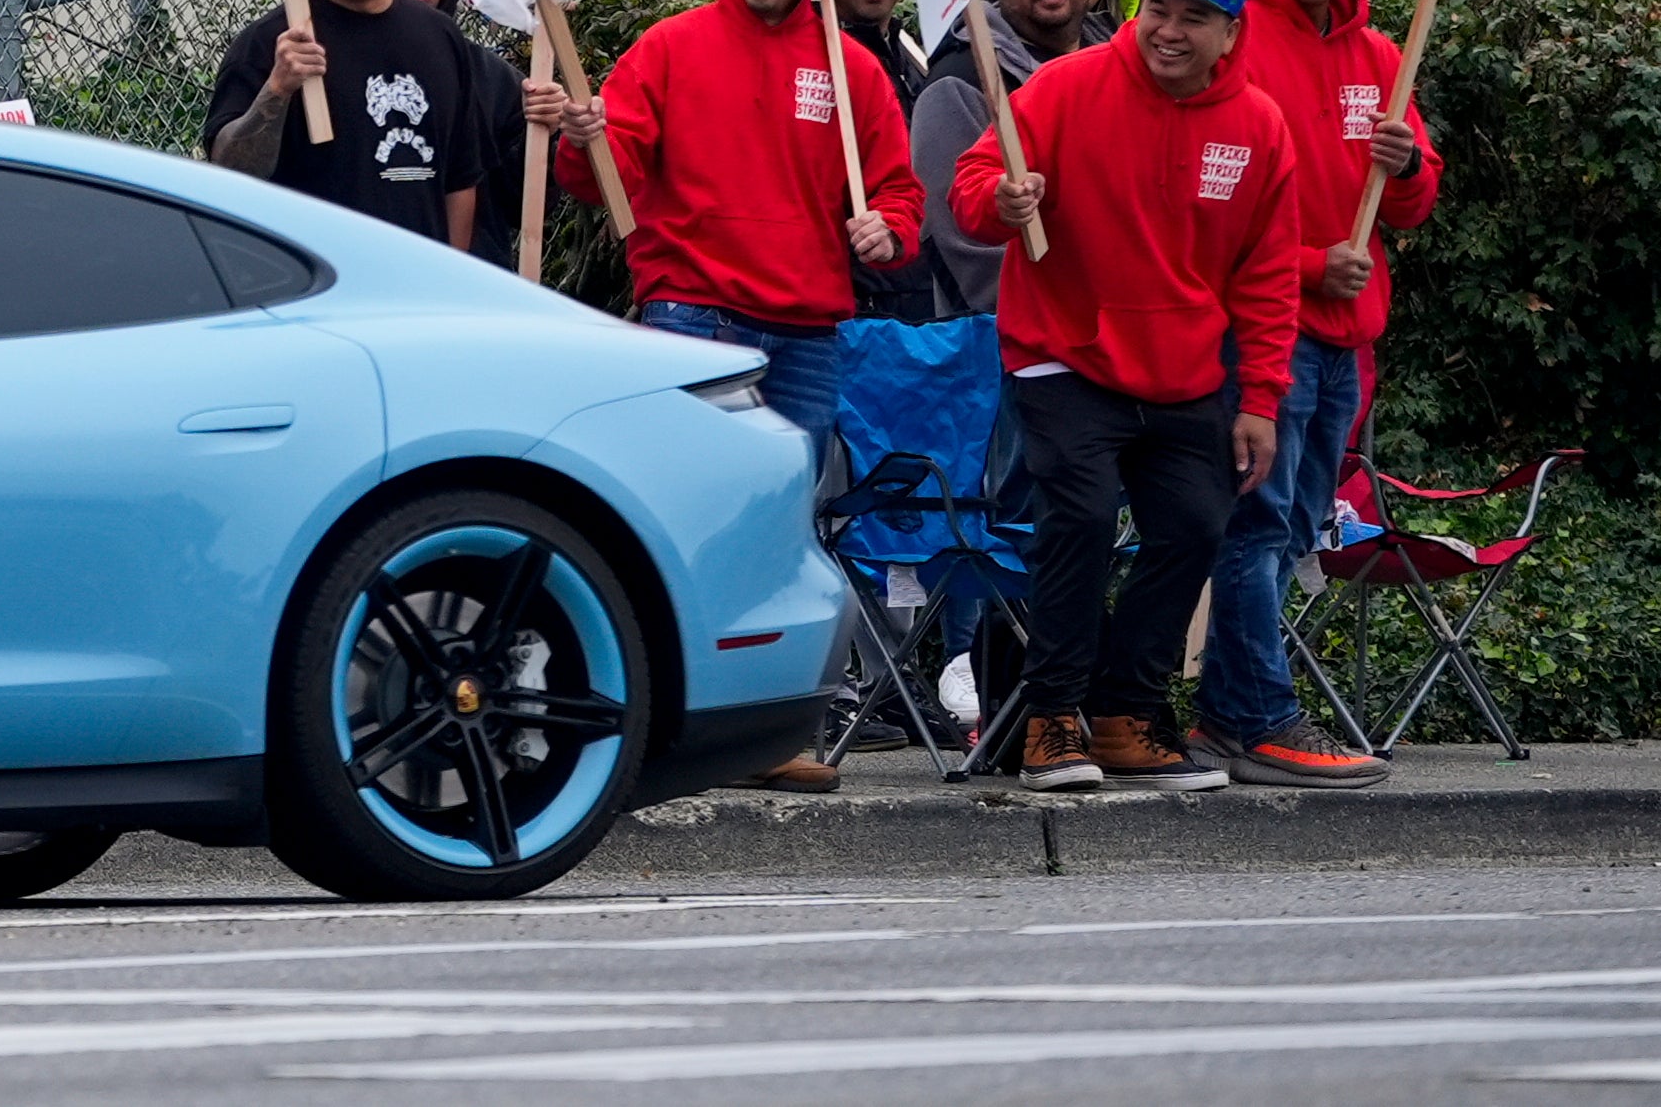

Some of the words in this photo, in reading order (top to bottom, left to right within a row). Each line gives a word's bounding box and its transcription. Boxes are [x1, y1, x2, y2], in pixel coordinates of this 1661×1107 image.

[797, 70, 833, 85] STRI
[797, 103, 829, 119] STRIKE
[1204, 144, 1248, 162] STRIKE
[1202, 162, 1241, 179] STRIKE
[1200, 180, 1232, 196] STRIKE
